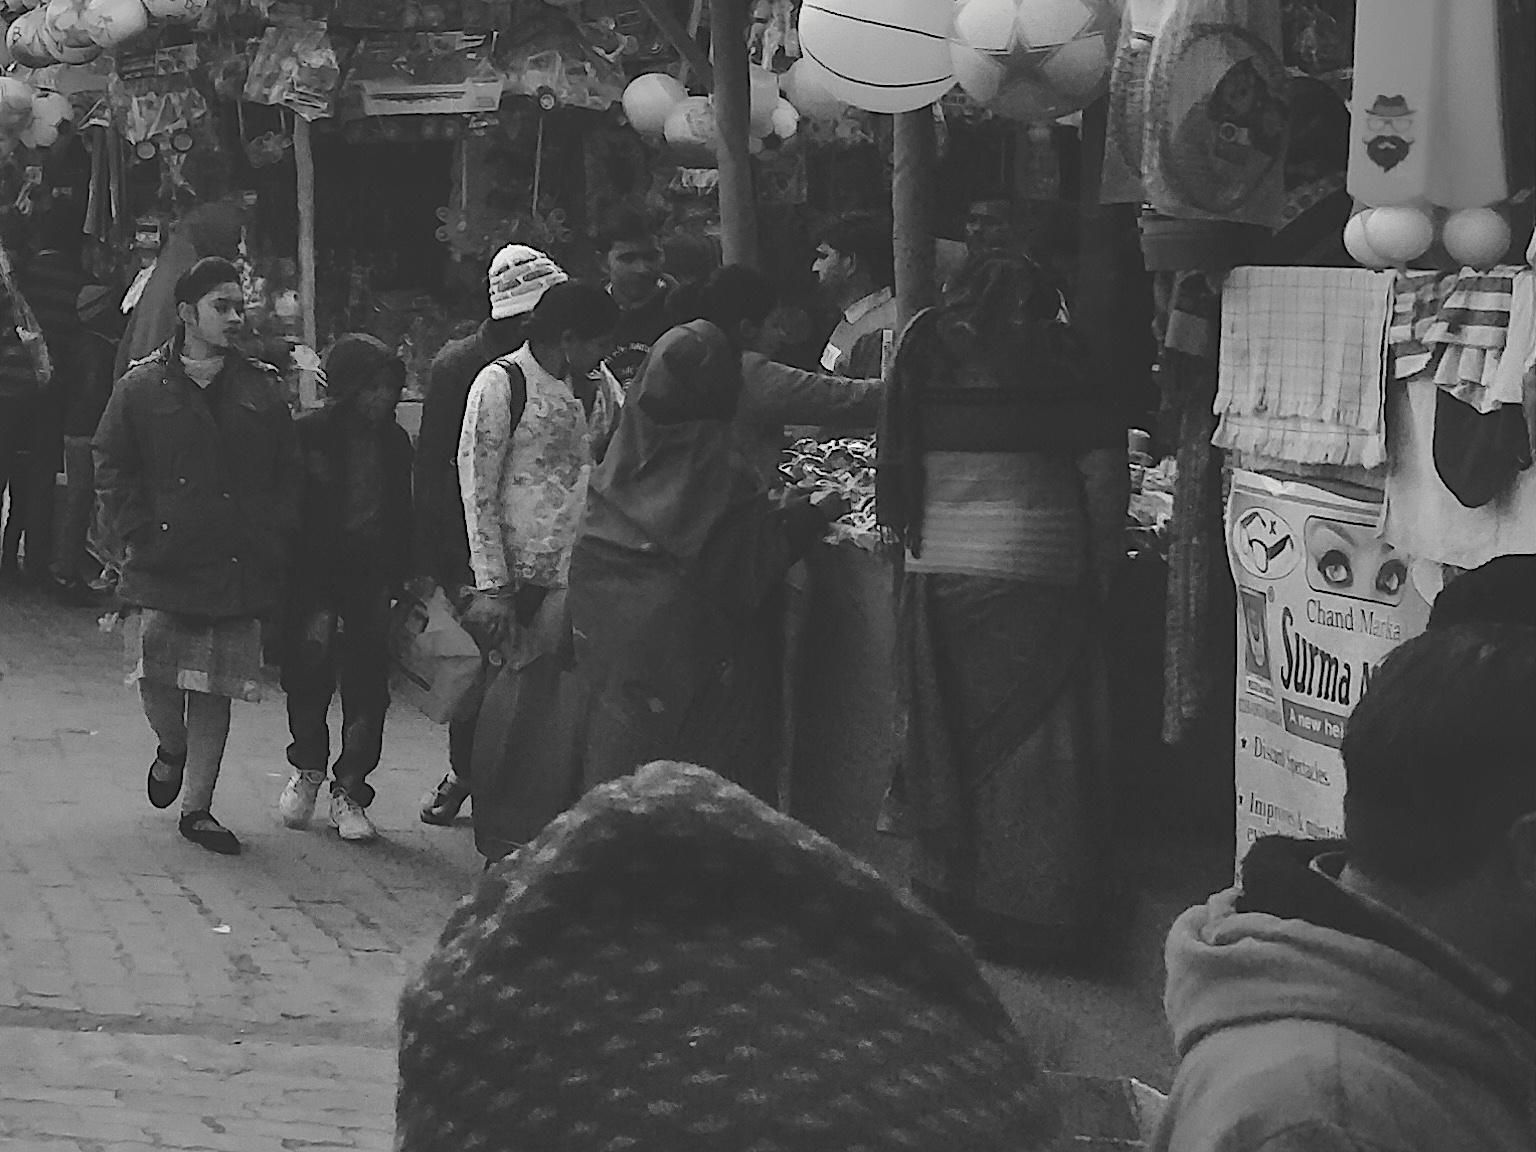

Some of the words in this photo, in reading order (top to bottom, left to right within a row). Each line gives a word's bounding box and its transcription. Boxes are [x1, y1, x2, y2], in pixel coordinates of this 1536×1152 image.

[1306, 600, 1355, 632] Chand
[1360, 607, 1402, 644] Marka
[1281, 606, 1351, 706] Surma
[1288, 707, 1299, 725] A
[1301, 710, 1321, 734] new
